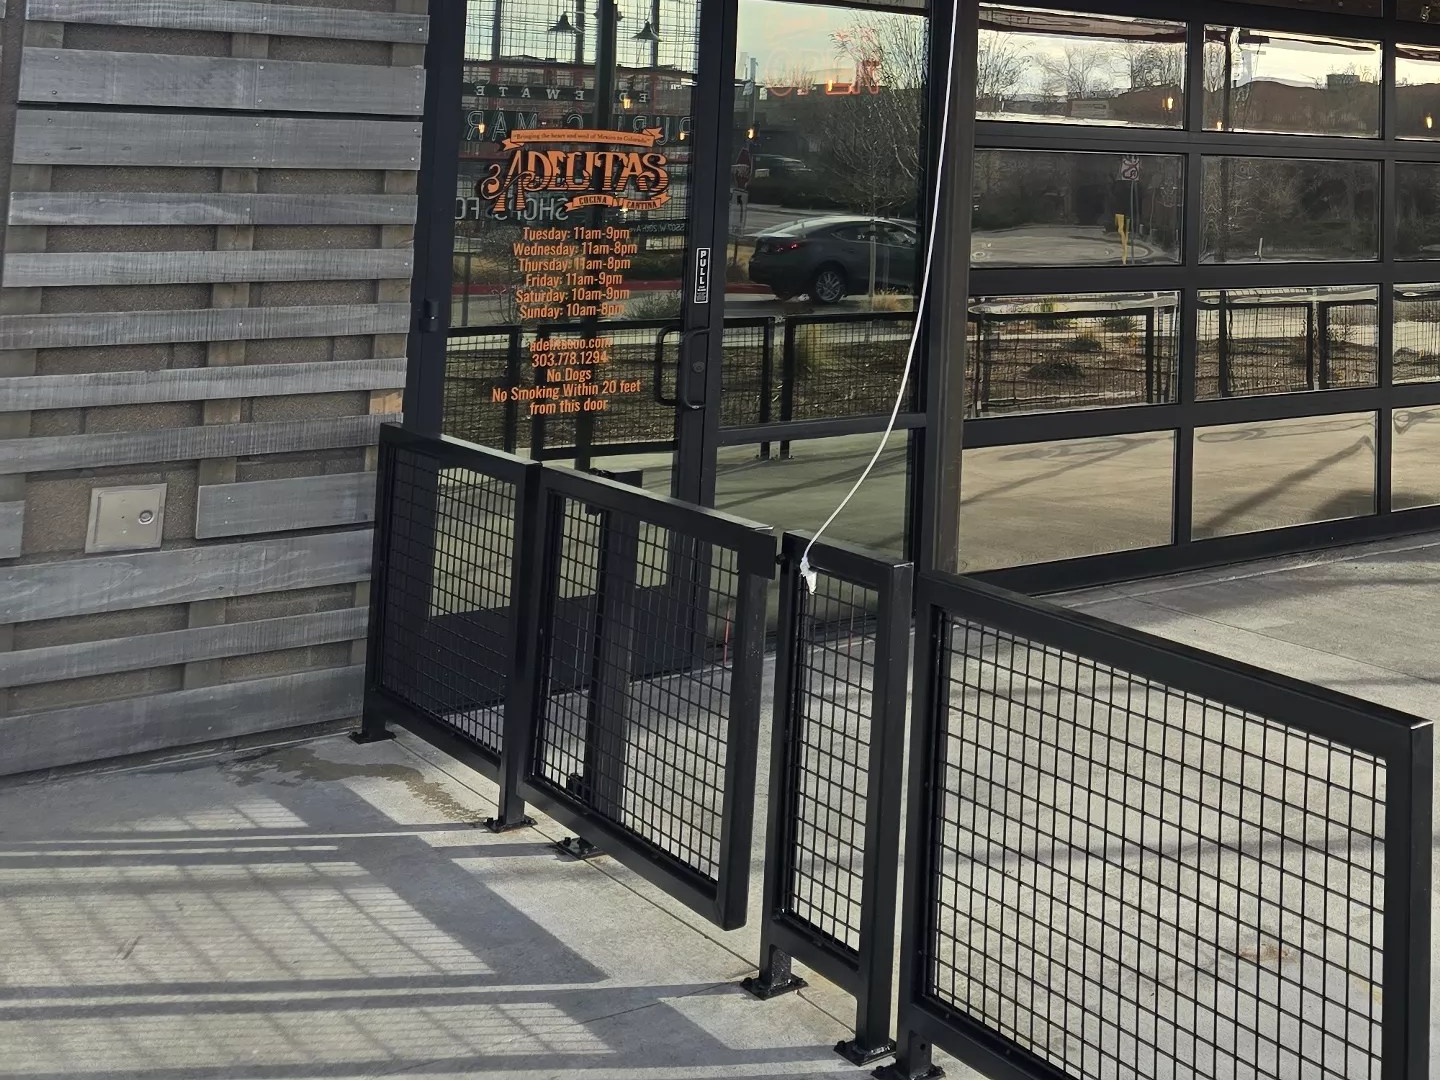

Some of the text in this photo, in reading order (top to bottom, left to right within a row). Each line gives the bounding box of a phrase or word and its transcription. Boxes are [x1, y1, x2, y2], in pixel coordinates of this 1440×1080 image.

[480, 150, 670, 213] ADELITAS
[578, 196, 657, 210] COCINA CANTINA
[523, 225, 630, 242] Tuesday: 11am-9pm
[513, 241, 638, 257] Wednesday: 11am-8pm
[518, 256, 631, 273] Thursday: 11am-8pm
[699, 250, 707, 285] PULL
[525, 273, 623, 289] Friday: 11am-9pm
[515, 288, 630, 305] Saturday: 10am-9pm
[519, 303, 624, 320] Sunday: 10am-8pm
[531, 350, 608, 368] 303.778.1294
[546, 368, 592, 383] No Dogs
[492, 379, 641, 402] No Smoking Within 20 feet
[529, 398, 609, 416] from this door
